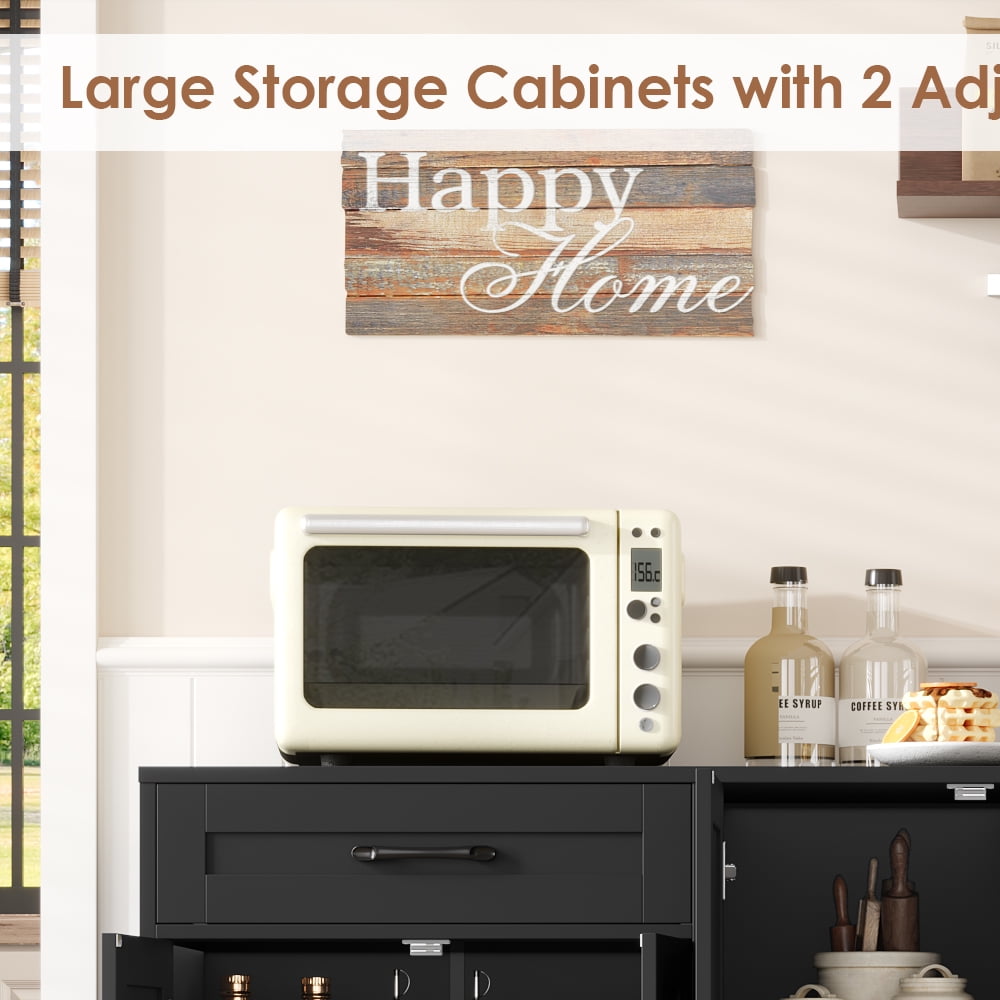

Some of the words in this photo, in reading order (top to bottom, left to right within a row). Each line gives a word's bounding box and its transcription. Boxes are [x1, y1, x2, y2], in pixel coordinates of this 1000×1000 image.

[356, 151, 645, 232] Happy
[459, 216, 756, 315] Home
[792, 698, 822, 709] SYRUP
[850, 700, 883, 712] COFFEE
[886, 700, 905, 712] SYR
